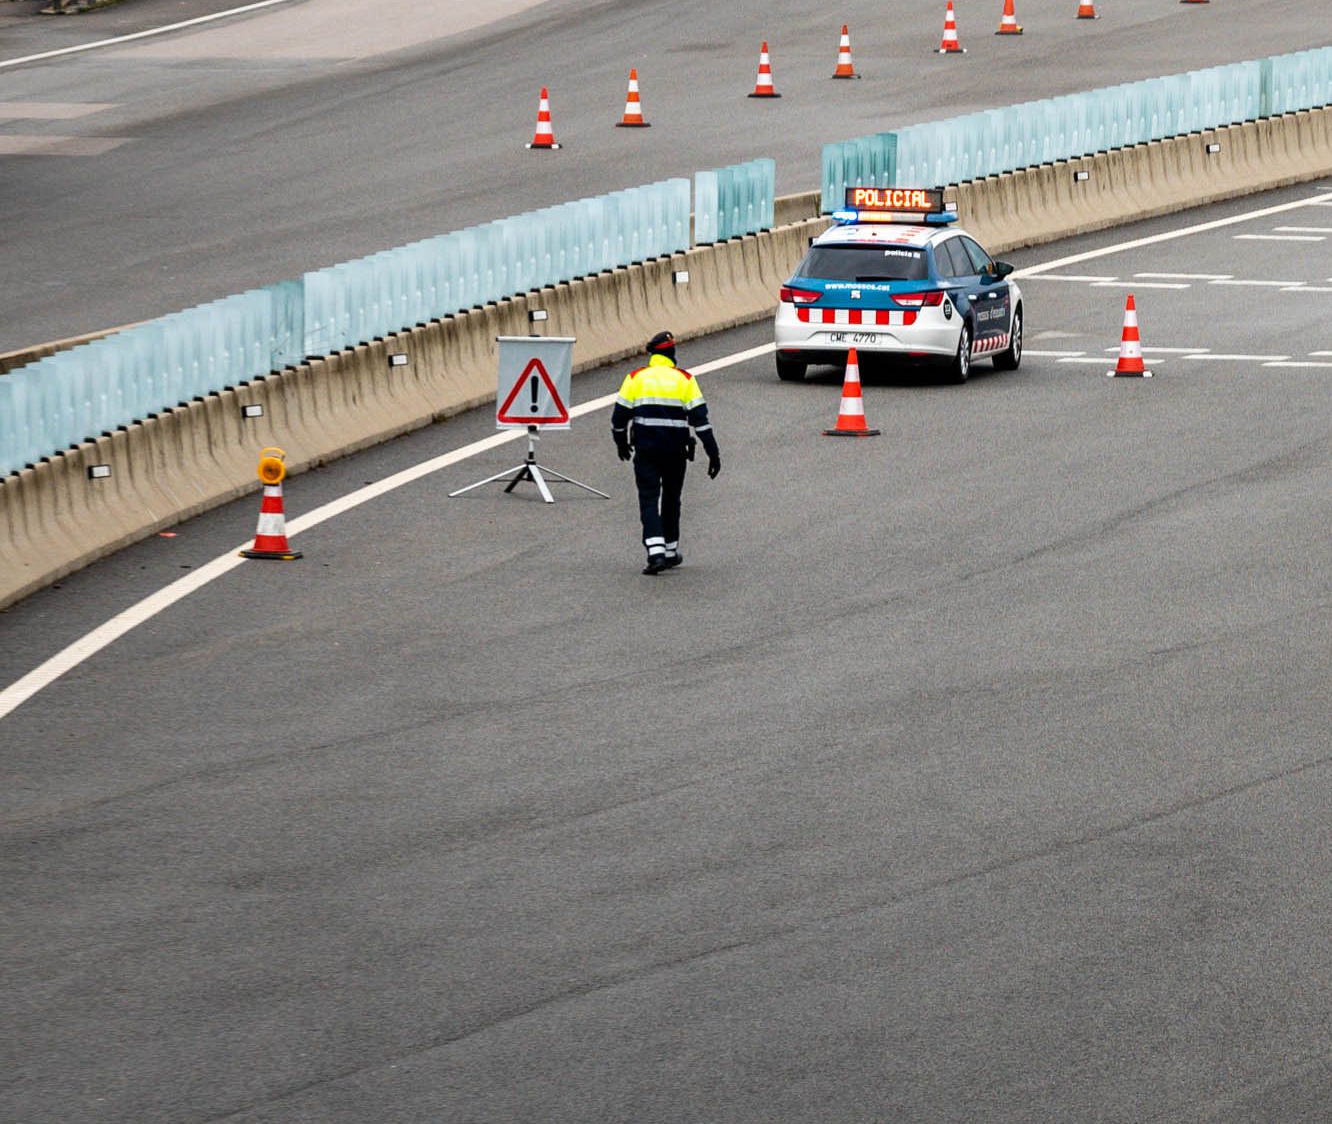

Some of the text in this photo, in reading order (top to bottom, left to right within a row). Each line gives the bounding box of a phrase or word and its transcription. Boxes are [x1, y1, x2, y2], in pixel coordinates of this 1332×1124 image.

[854, 188, 932, 208] POLICIAL
[830, 332, 877, 344] CME 4770
